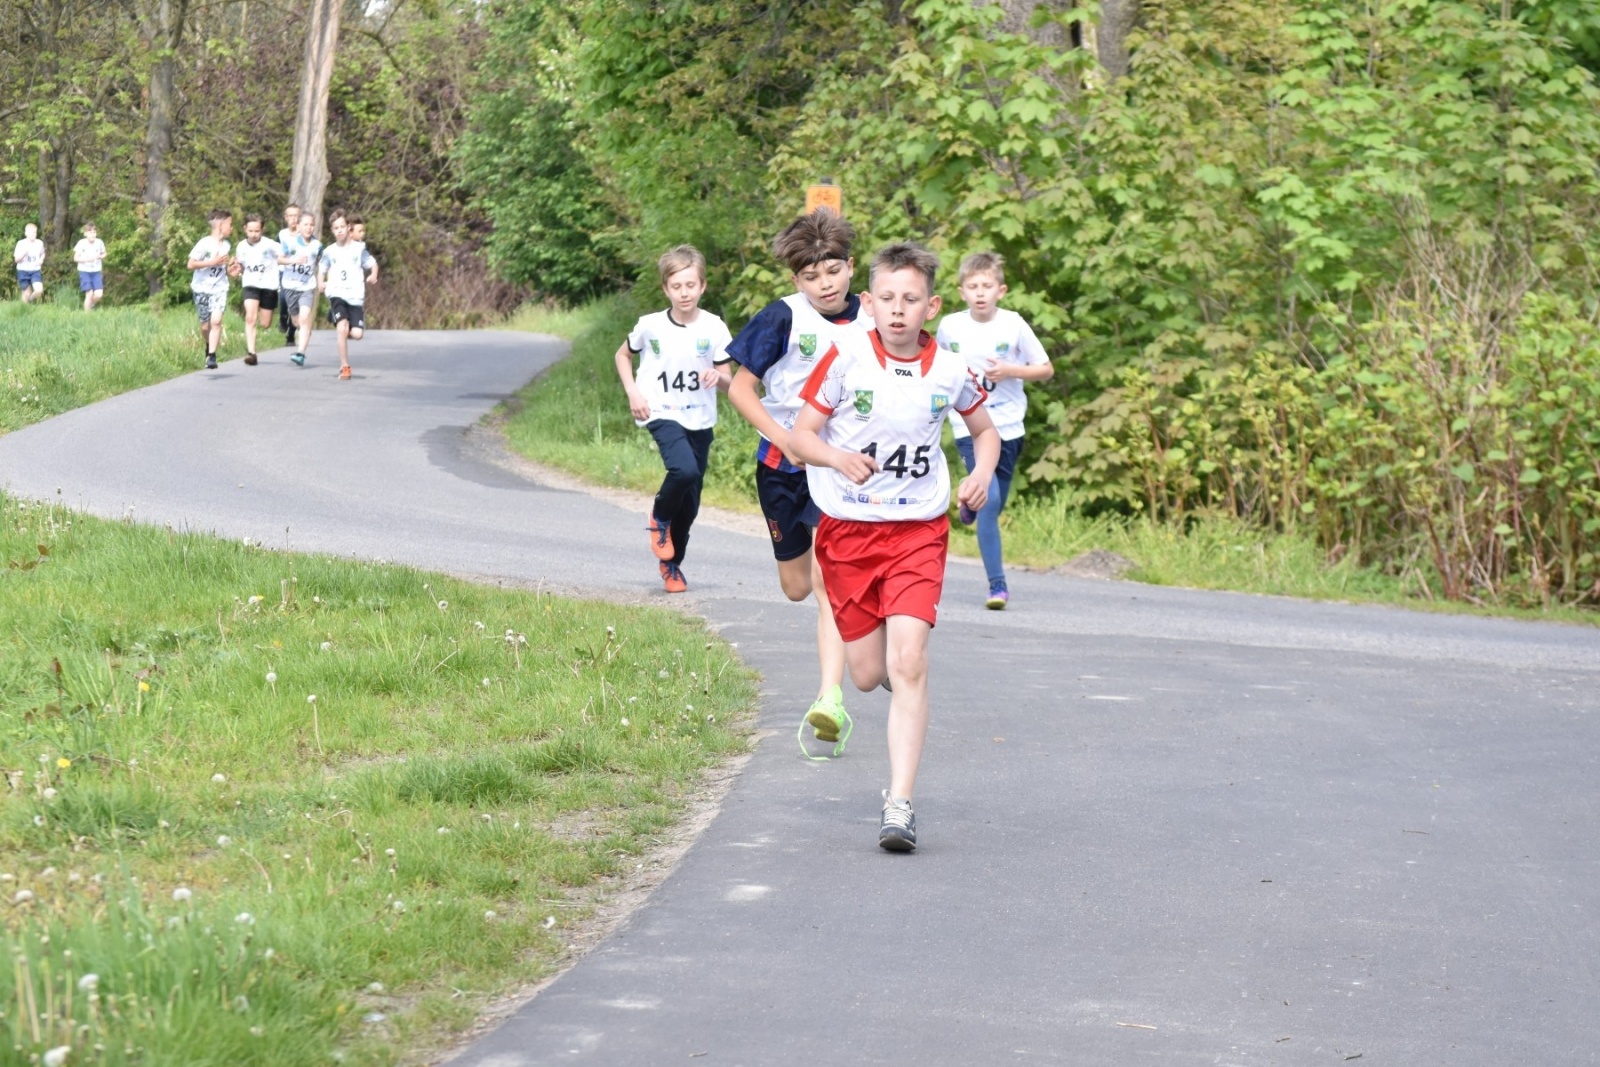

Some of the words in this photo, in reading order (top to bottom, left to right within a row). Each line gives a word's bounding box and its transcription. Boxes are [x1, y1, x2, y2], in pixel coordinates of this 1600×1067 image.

[247, 264, 265, 273] 142
[292, 263, 311, 275] 162
[341, 270, 347, 281] 3
[657, 370, 700, 393] 143
[860, 441, 932, 480] 145
